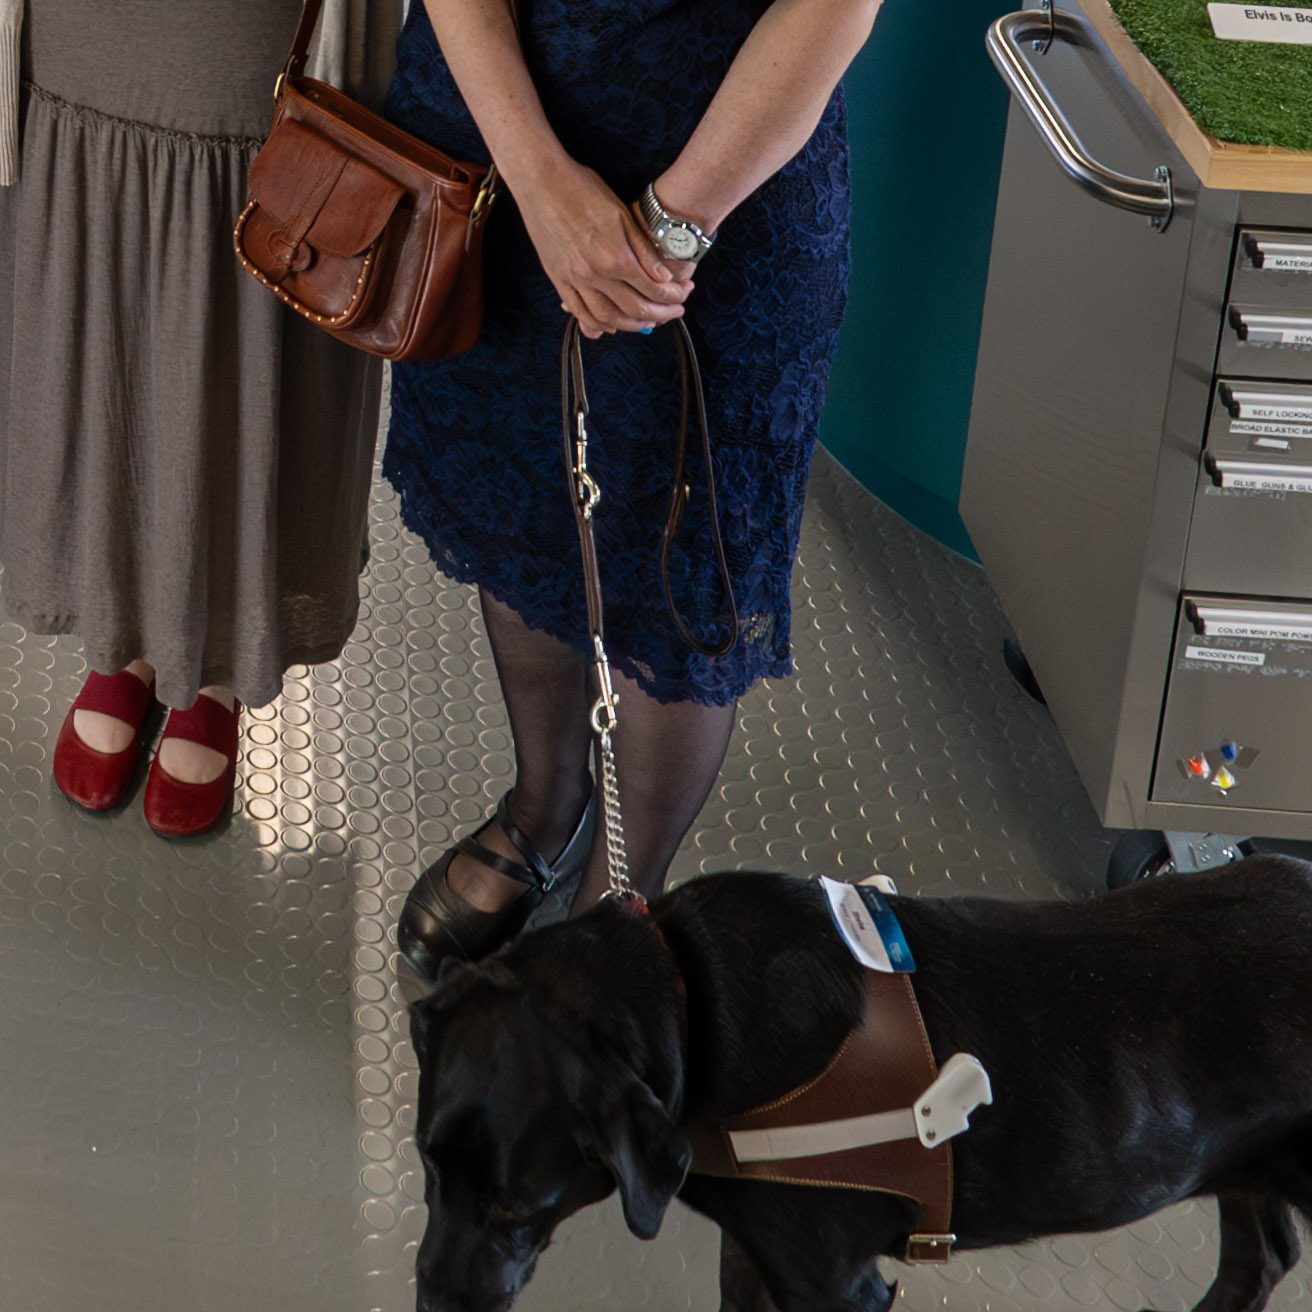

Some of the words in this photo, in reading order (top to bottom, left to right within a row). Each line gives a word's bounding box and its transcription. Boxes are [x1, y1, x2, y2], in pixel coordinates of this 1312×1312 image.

[1244, 9, 1276, 20] Elvis
[1280, 12, 1292, 22] Is
[1230, 423, 1263, 432] BROAD
[1264, 426, 1300, 434] ELASTIC
[1234, 480, 1256, 488] GLUE
[1217, 627, 1248, 635] COLOR
[1197, 650, 1235, 660] WOODEN
[1237, 654, 1259, 662] PEGS
